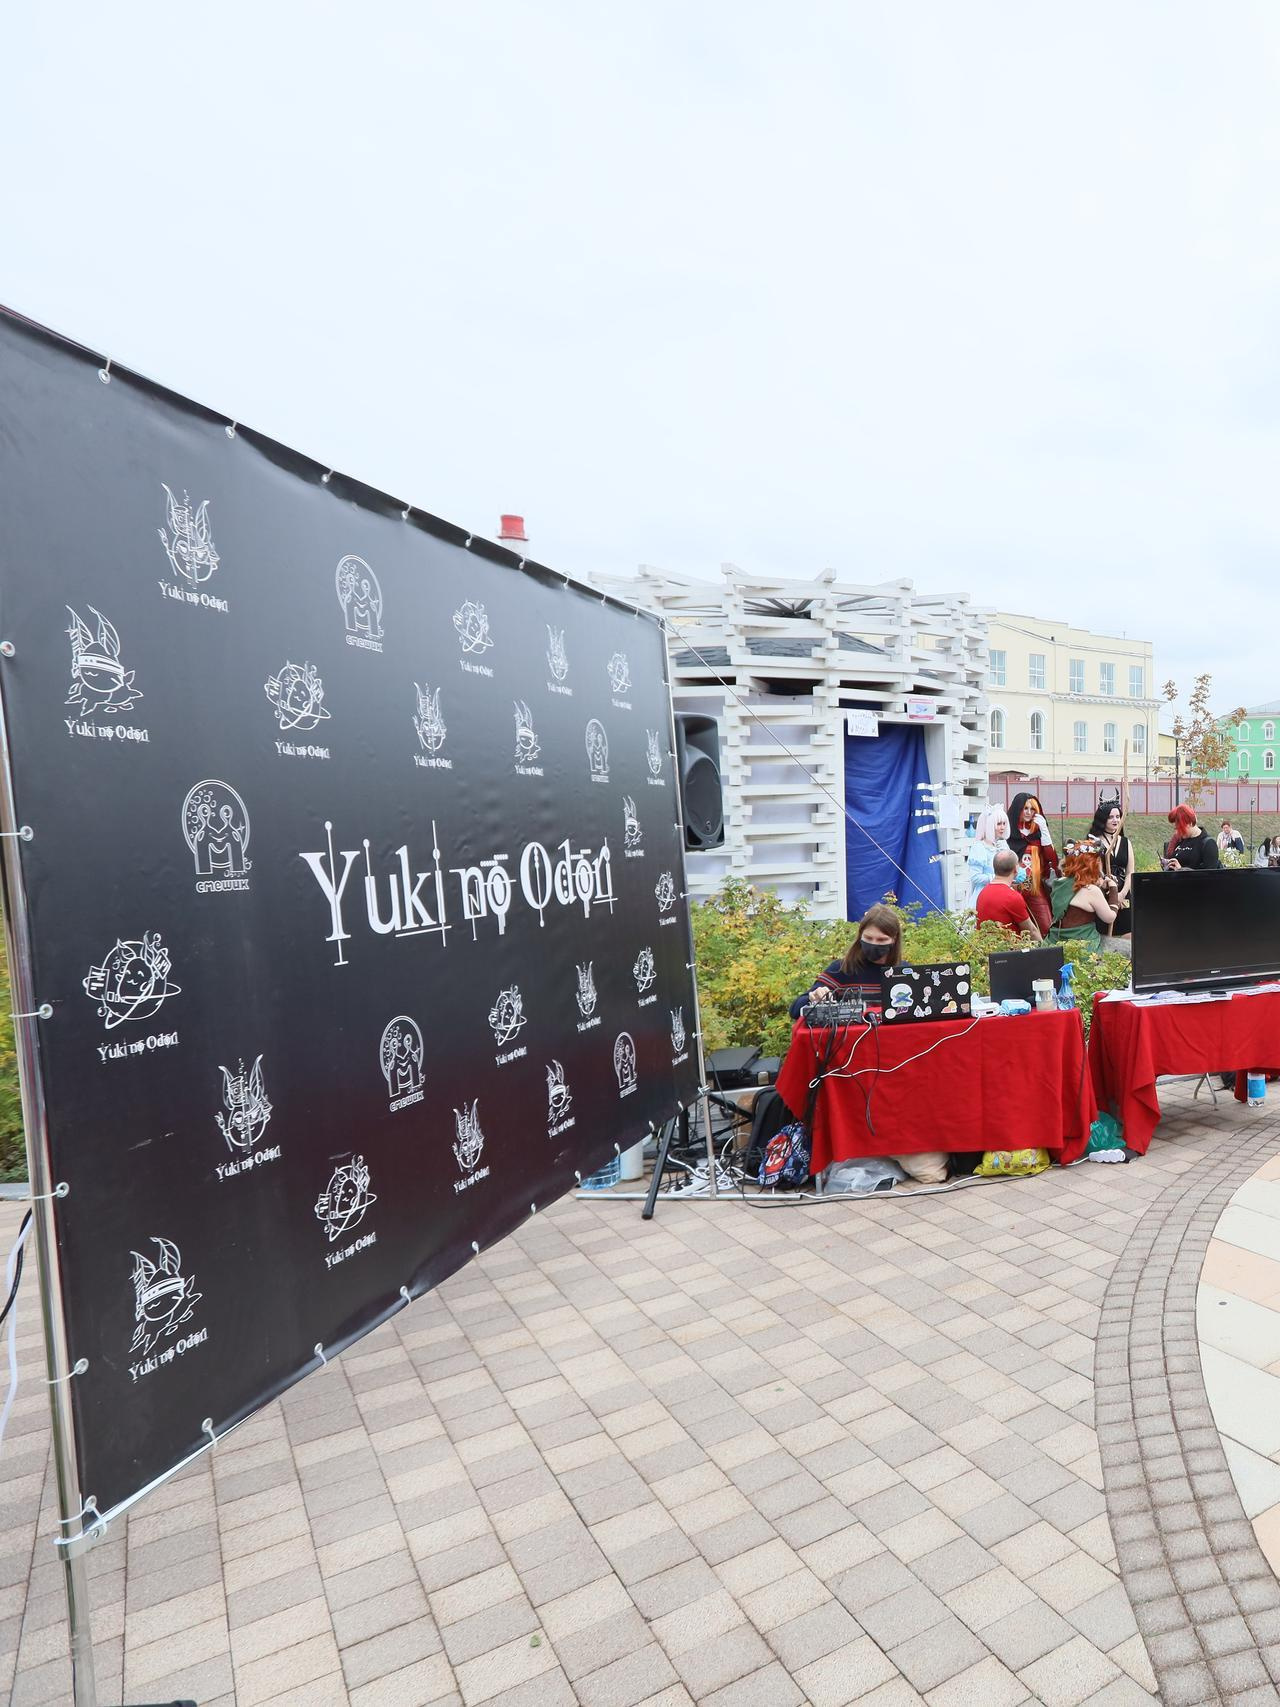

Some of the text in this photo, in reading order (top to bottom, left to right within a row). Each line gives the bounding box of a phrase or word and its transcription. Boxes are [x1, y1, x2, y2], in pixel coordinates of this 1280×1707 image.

[158, 579, 184, 601] Yuki
[64, 716, 96, 737] Yuki
[299, 821, 452, 965] Yuki
[97, 1043, 128, 1064] Yuki
[215, 1160, 240, 1182] Yuki
[325, 1249, 344, 1270] Yuki
[128, 1355, 159, 1384] Yuki
